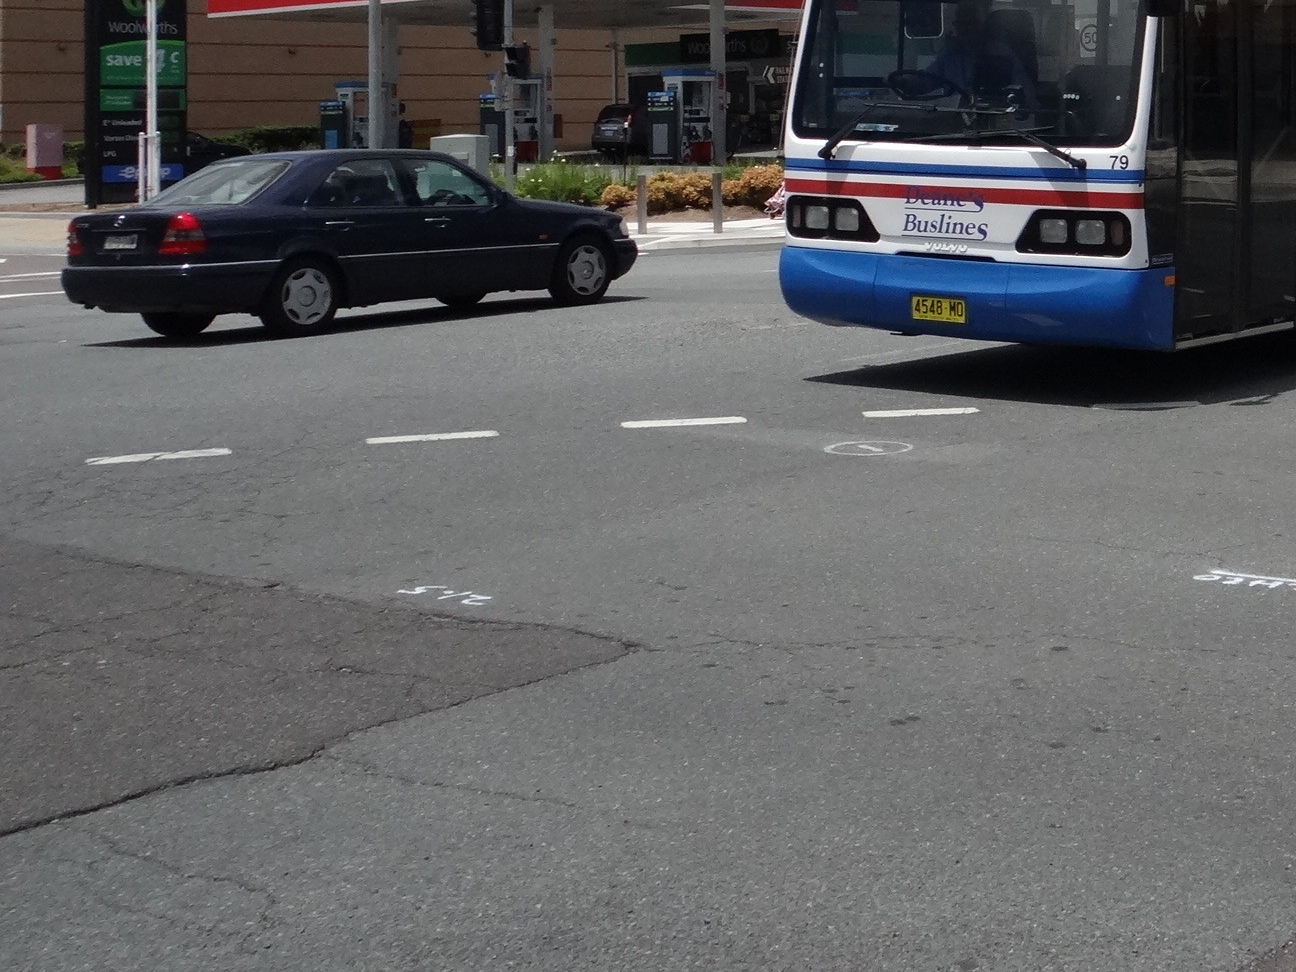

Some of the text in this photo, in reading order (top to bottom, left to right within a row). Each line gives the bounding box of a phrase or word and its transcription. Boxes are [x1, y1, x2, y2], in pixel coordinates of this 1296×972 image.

[105, 54, 142, 66] save
[1109, 155, 1129, 170] 79
[902, 213, 988, 241] Buslines
